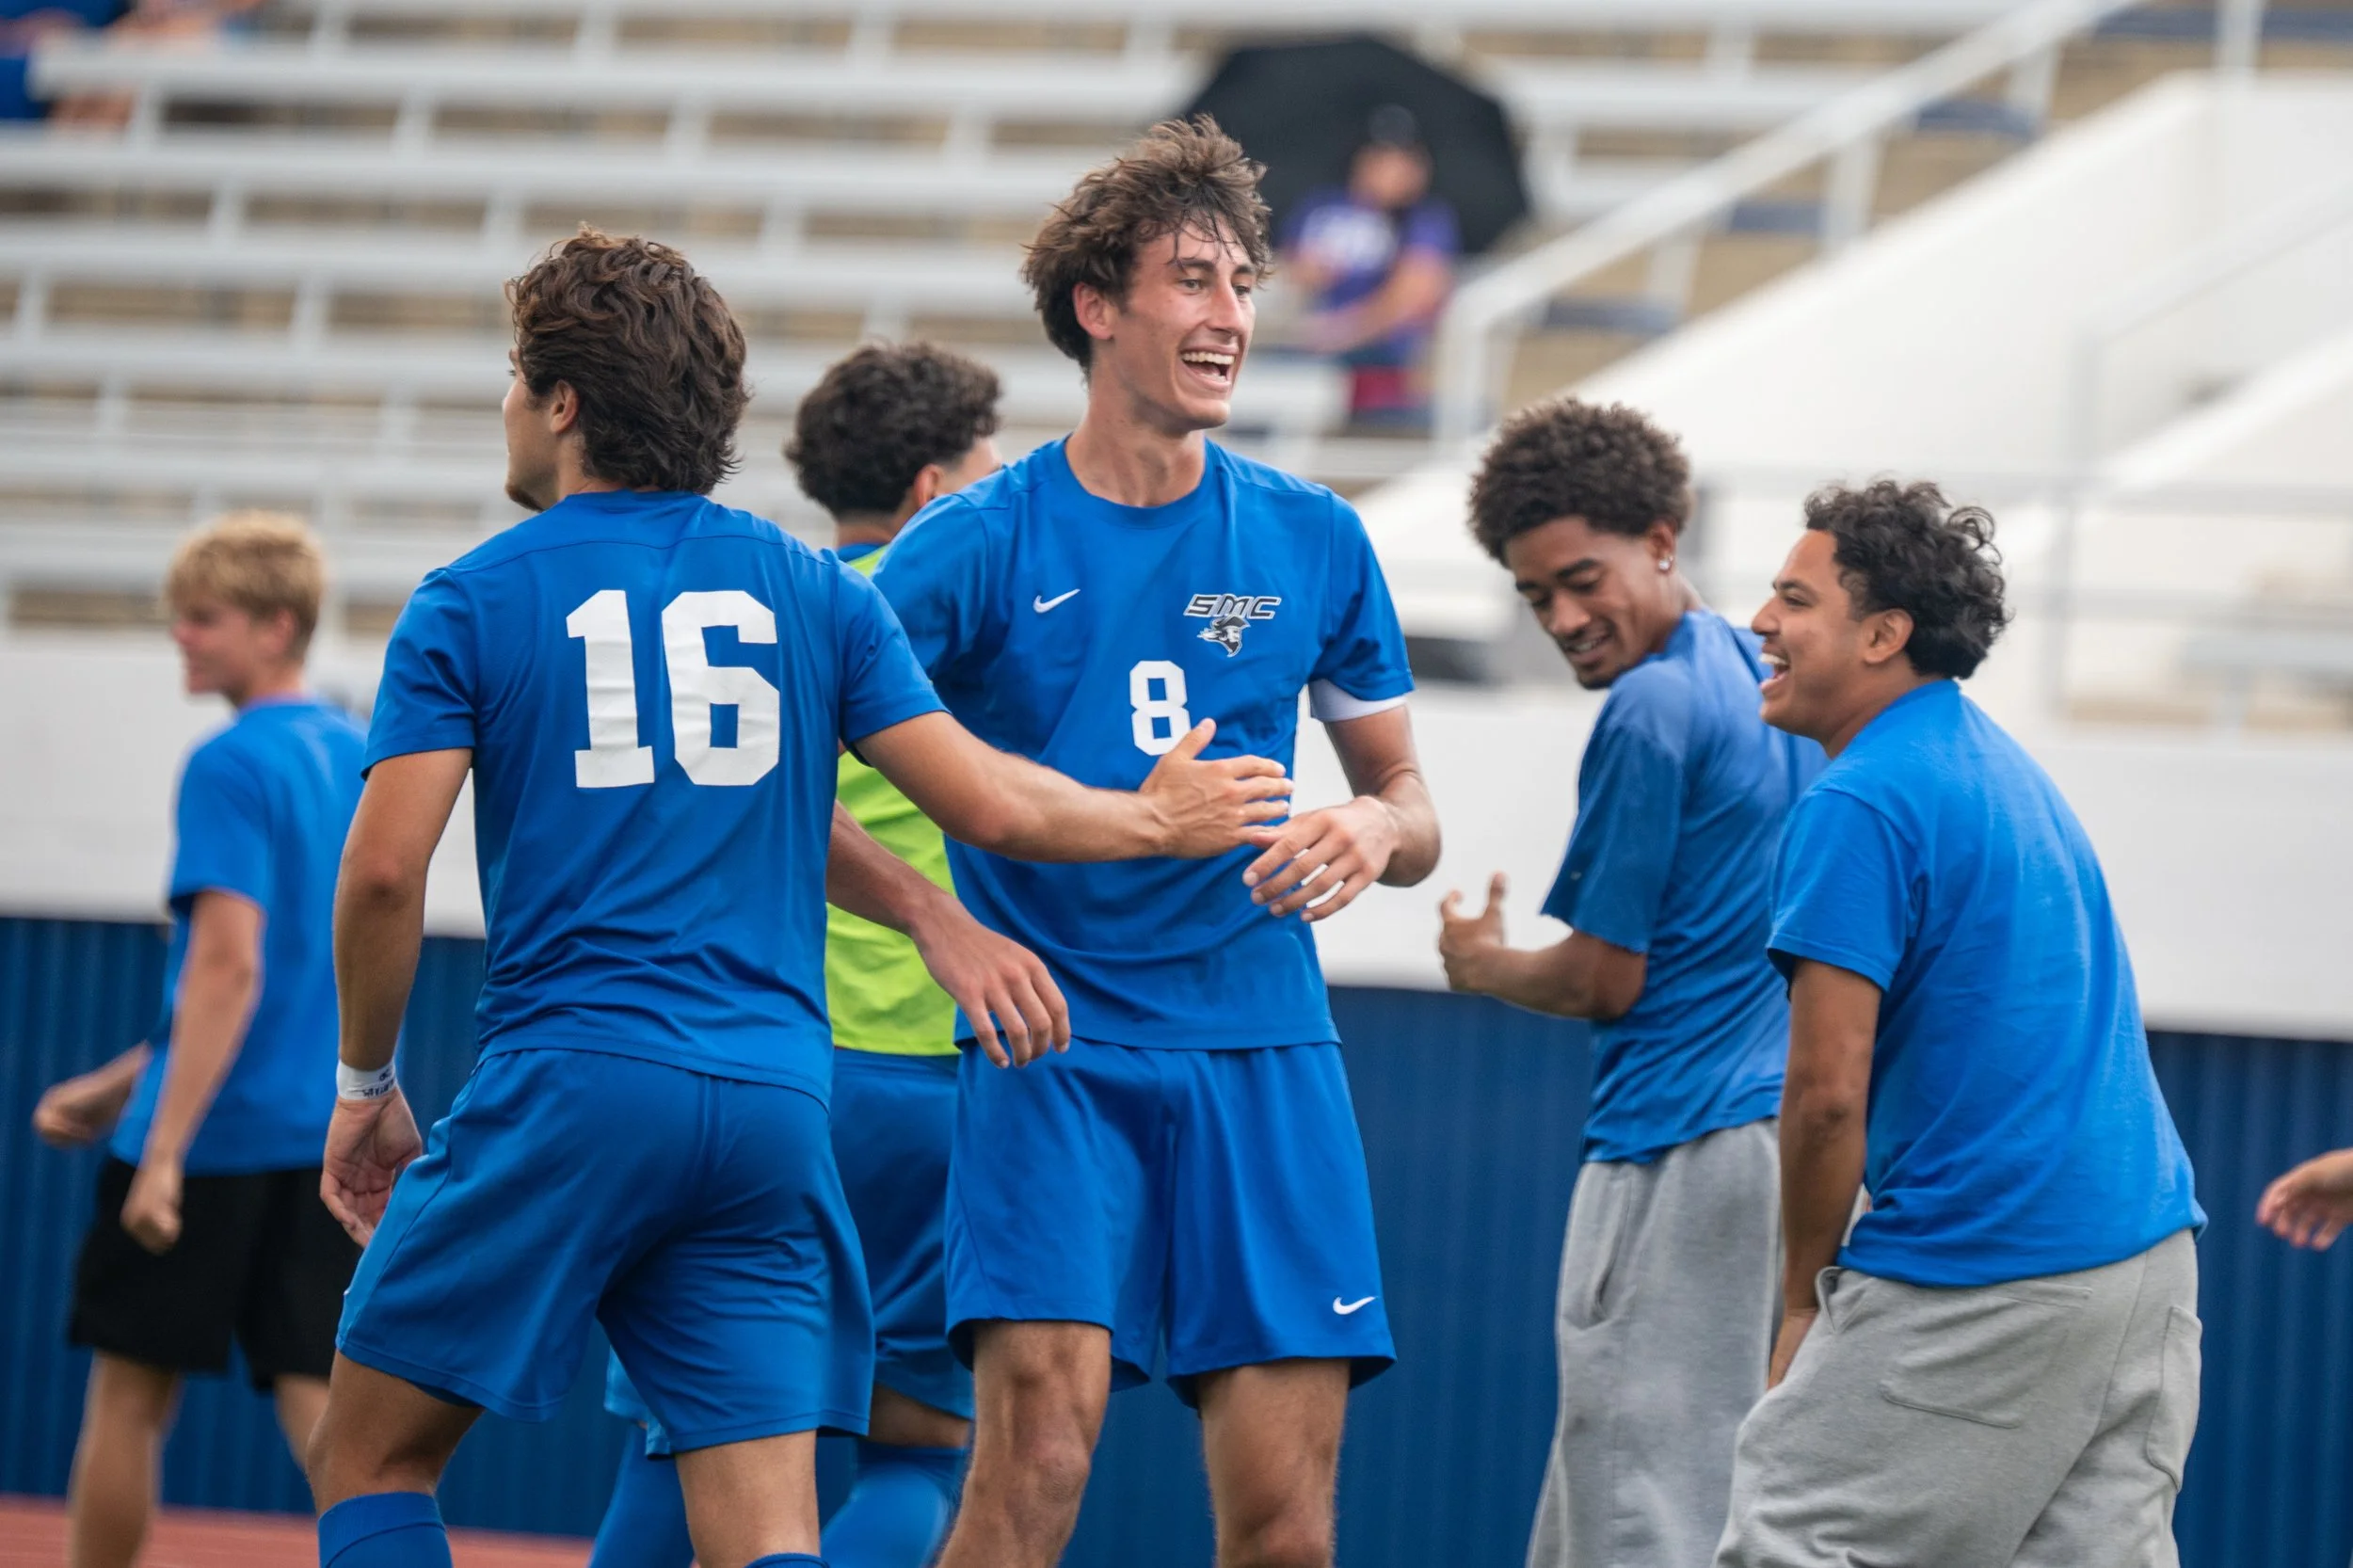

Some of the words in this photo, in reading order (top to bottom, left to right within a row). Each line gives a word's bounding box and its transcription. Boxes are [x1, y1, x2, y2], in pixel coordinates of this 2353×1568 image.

[1183, 593, 1282, 619] SMC
[566, 590, 780, 788] 16
[1129, 660, 1192, 756] 8
